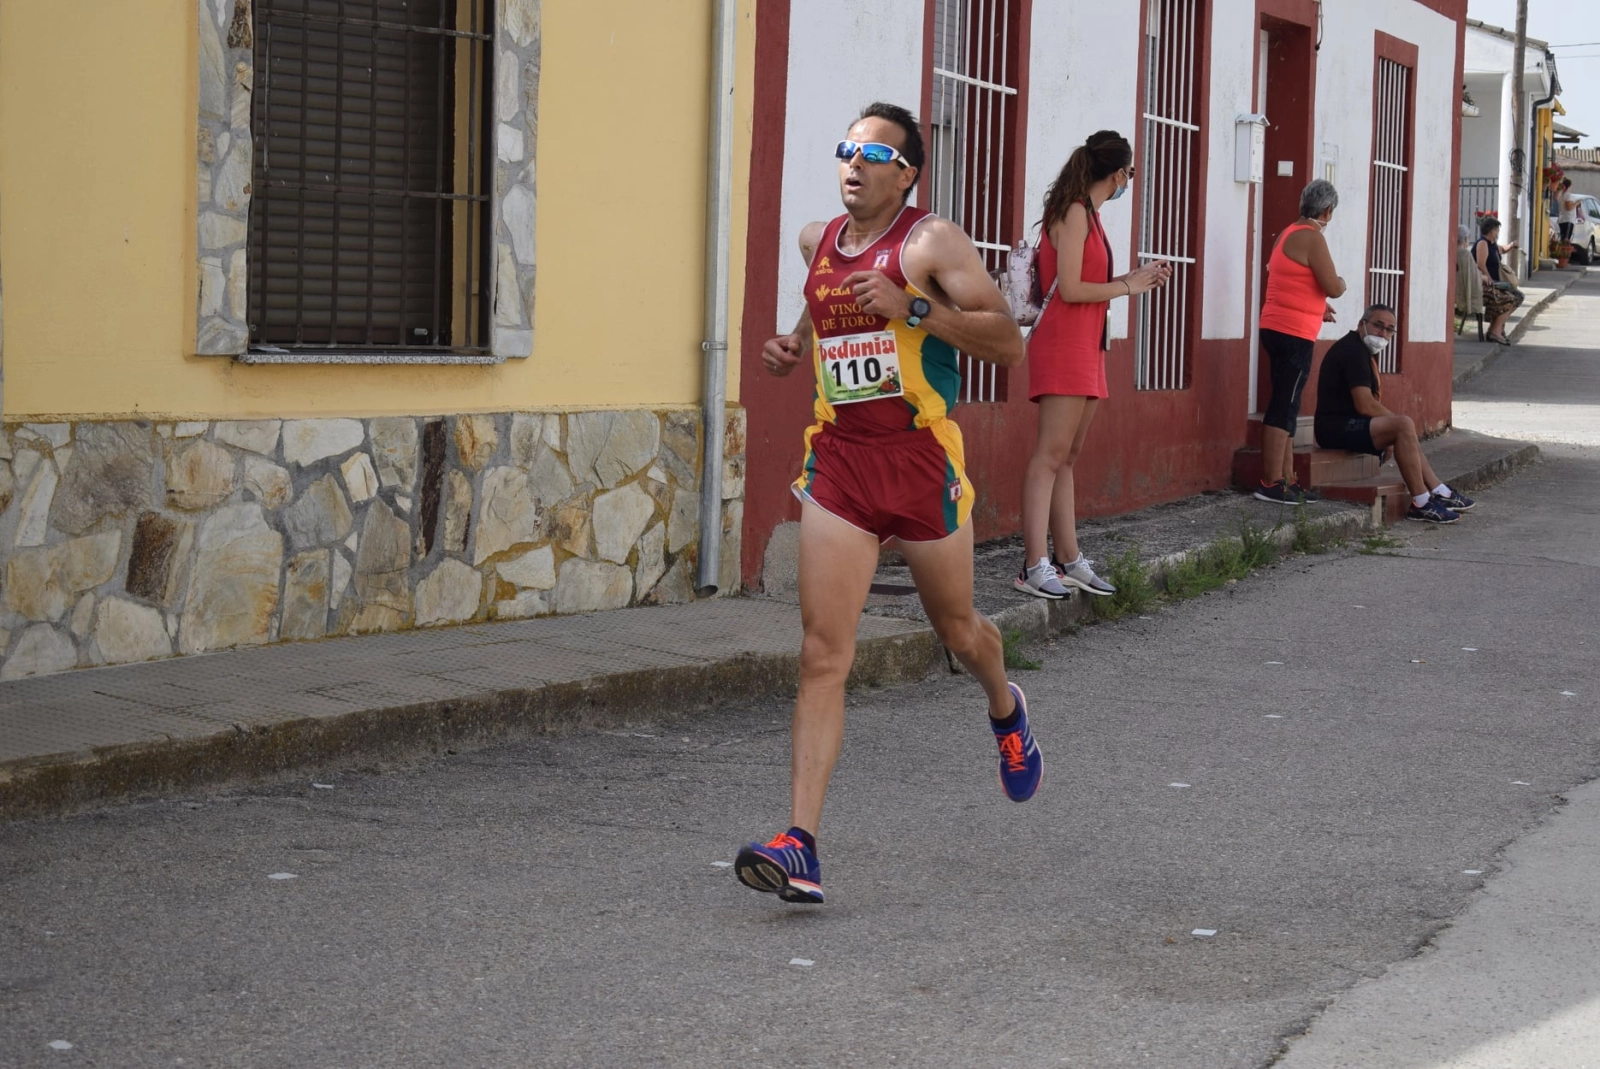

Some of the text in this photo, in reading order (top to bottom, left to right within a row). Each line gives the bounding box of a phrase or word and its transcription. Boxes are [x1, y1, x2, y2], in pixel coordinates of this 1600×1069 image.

[822, 315, 876, 330] DE TORO
[831, 357, 882, 387] 110
